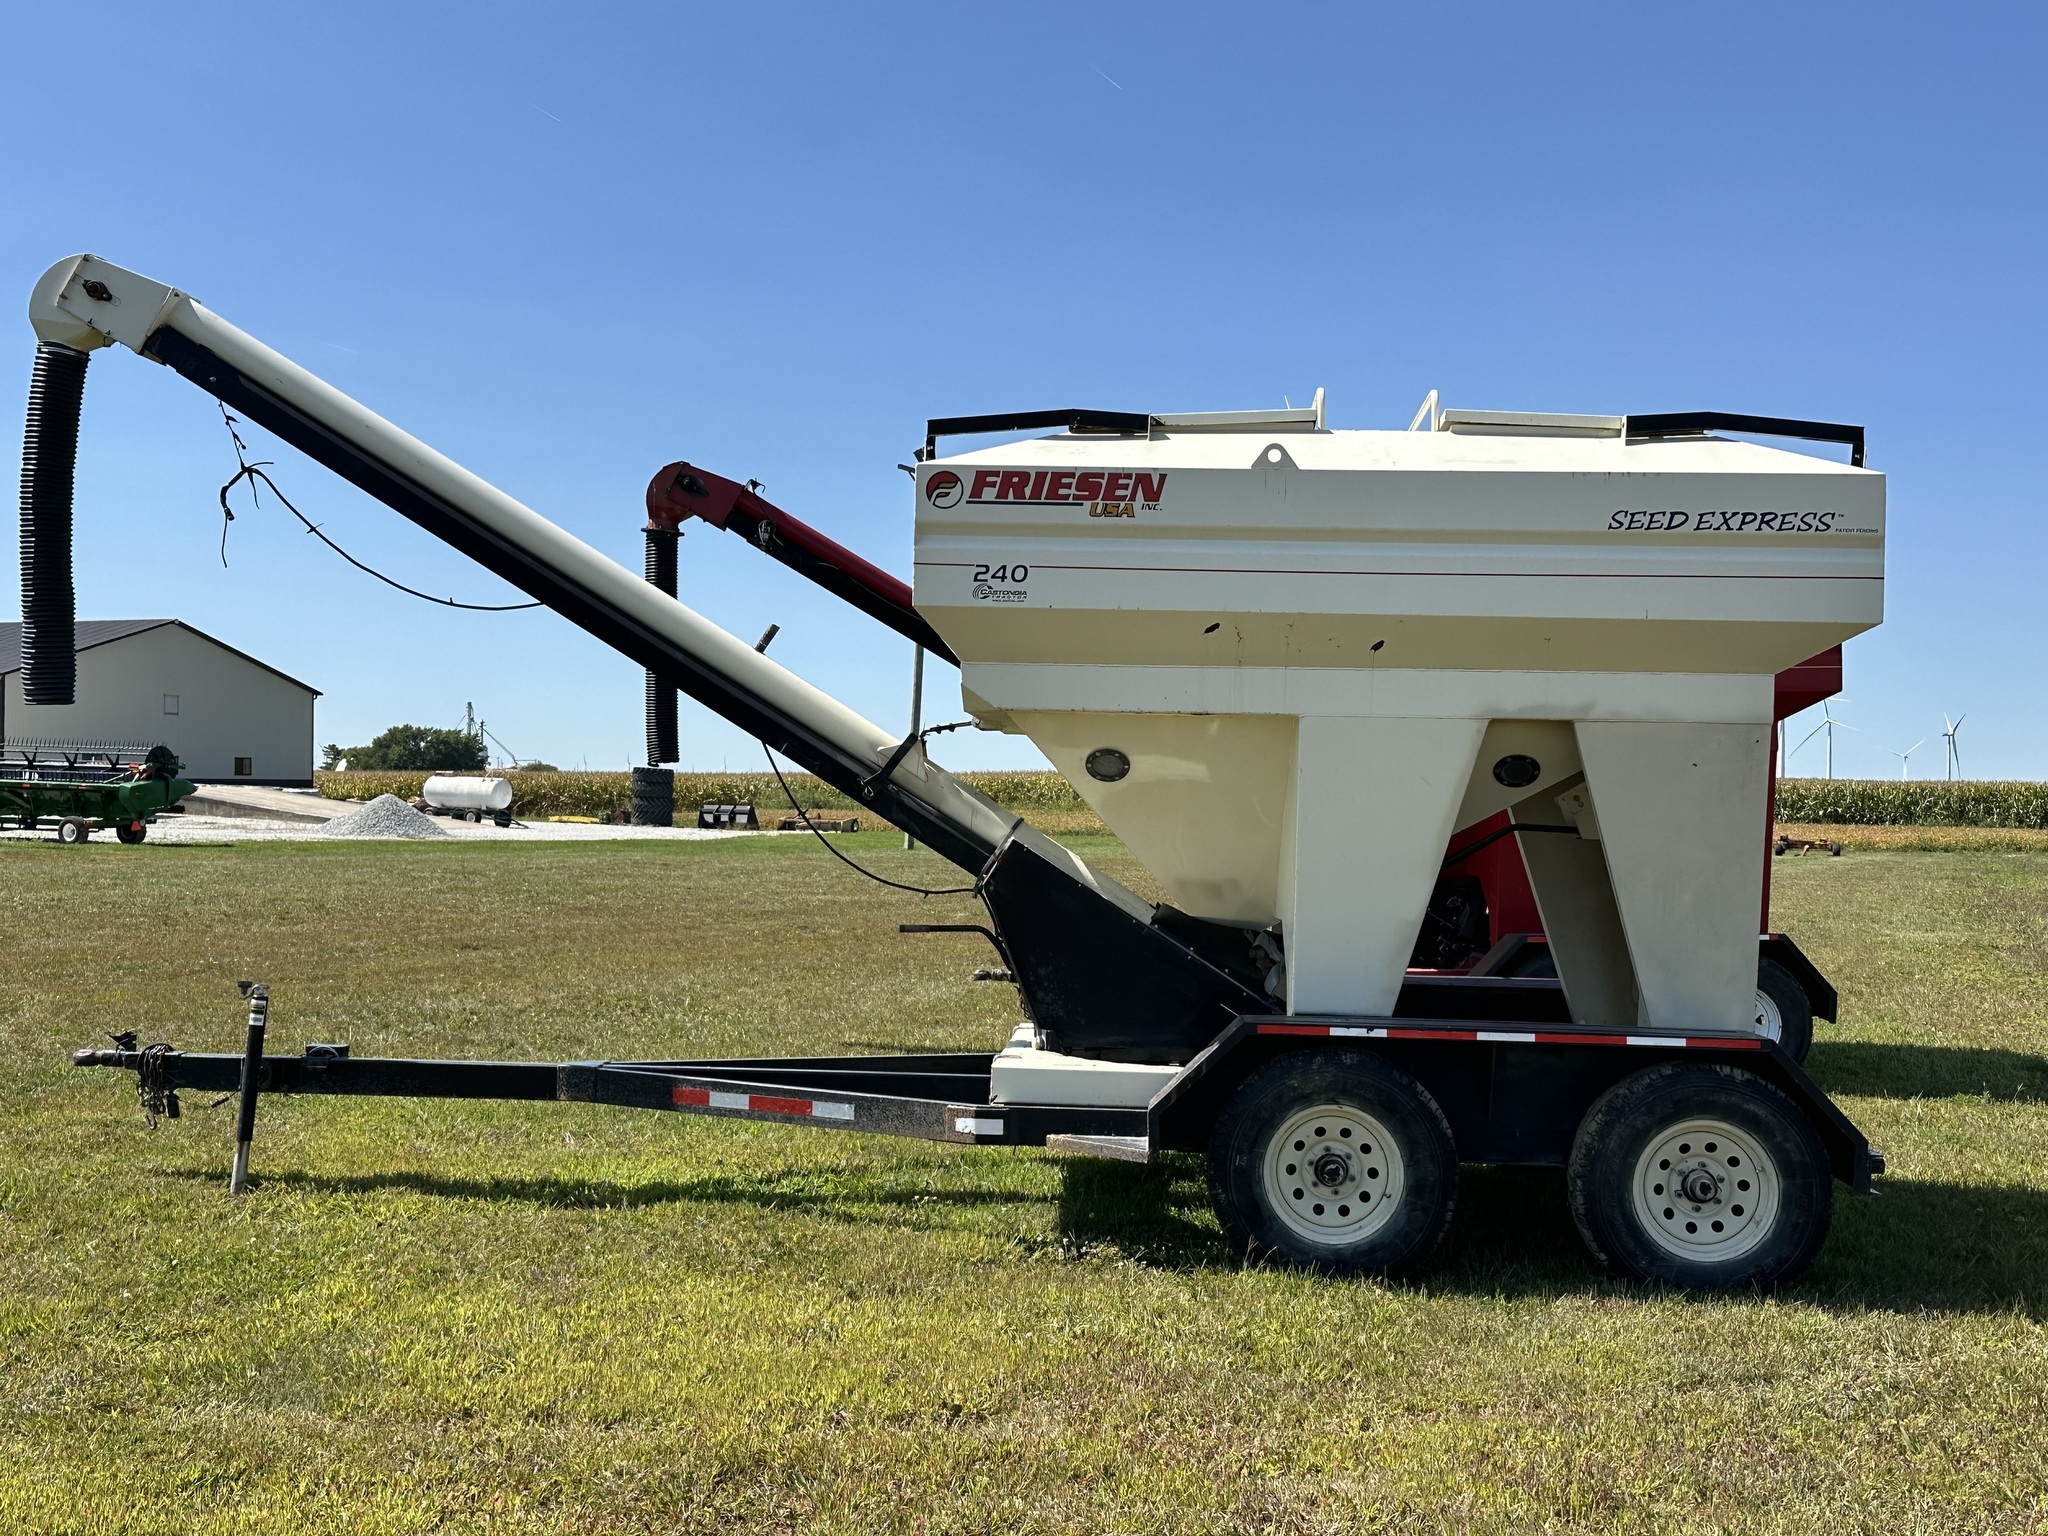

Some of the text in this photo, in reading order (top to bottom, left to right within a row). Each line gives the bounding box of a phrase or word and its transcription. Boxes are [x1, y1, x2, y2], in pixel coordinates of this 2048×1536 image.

[968, 470, 1168, 503] FRIESEN
[1089, 502, 1163, 518] USA INC.
[1608, 509, 1689, 531] SEED
[1693, 511, 1836, 533] EXPRESS
[973, 564, 1029, 583] 240
